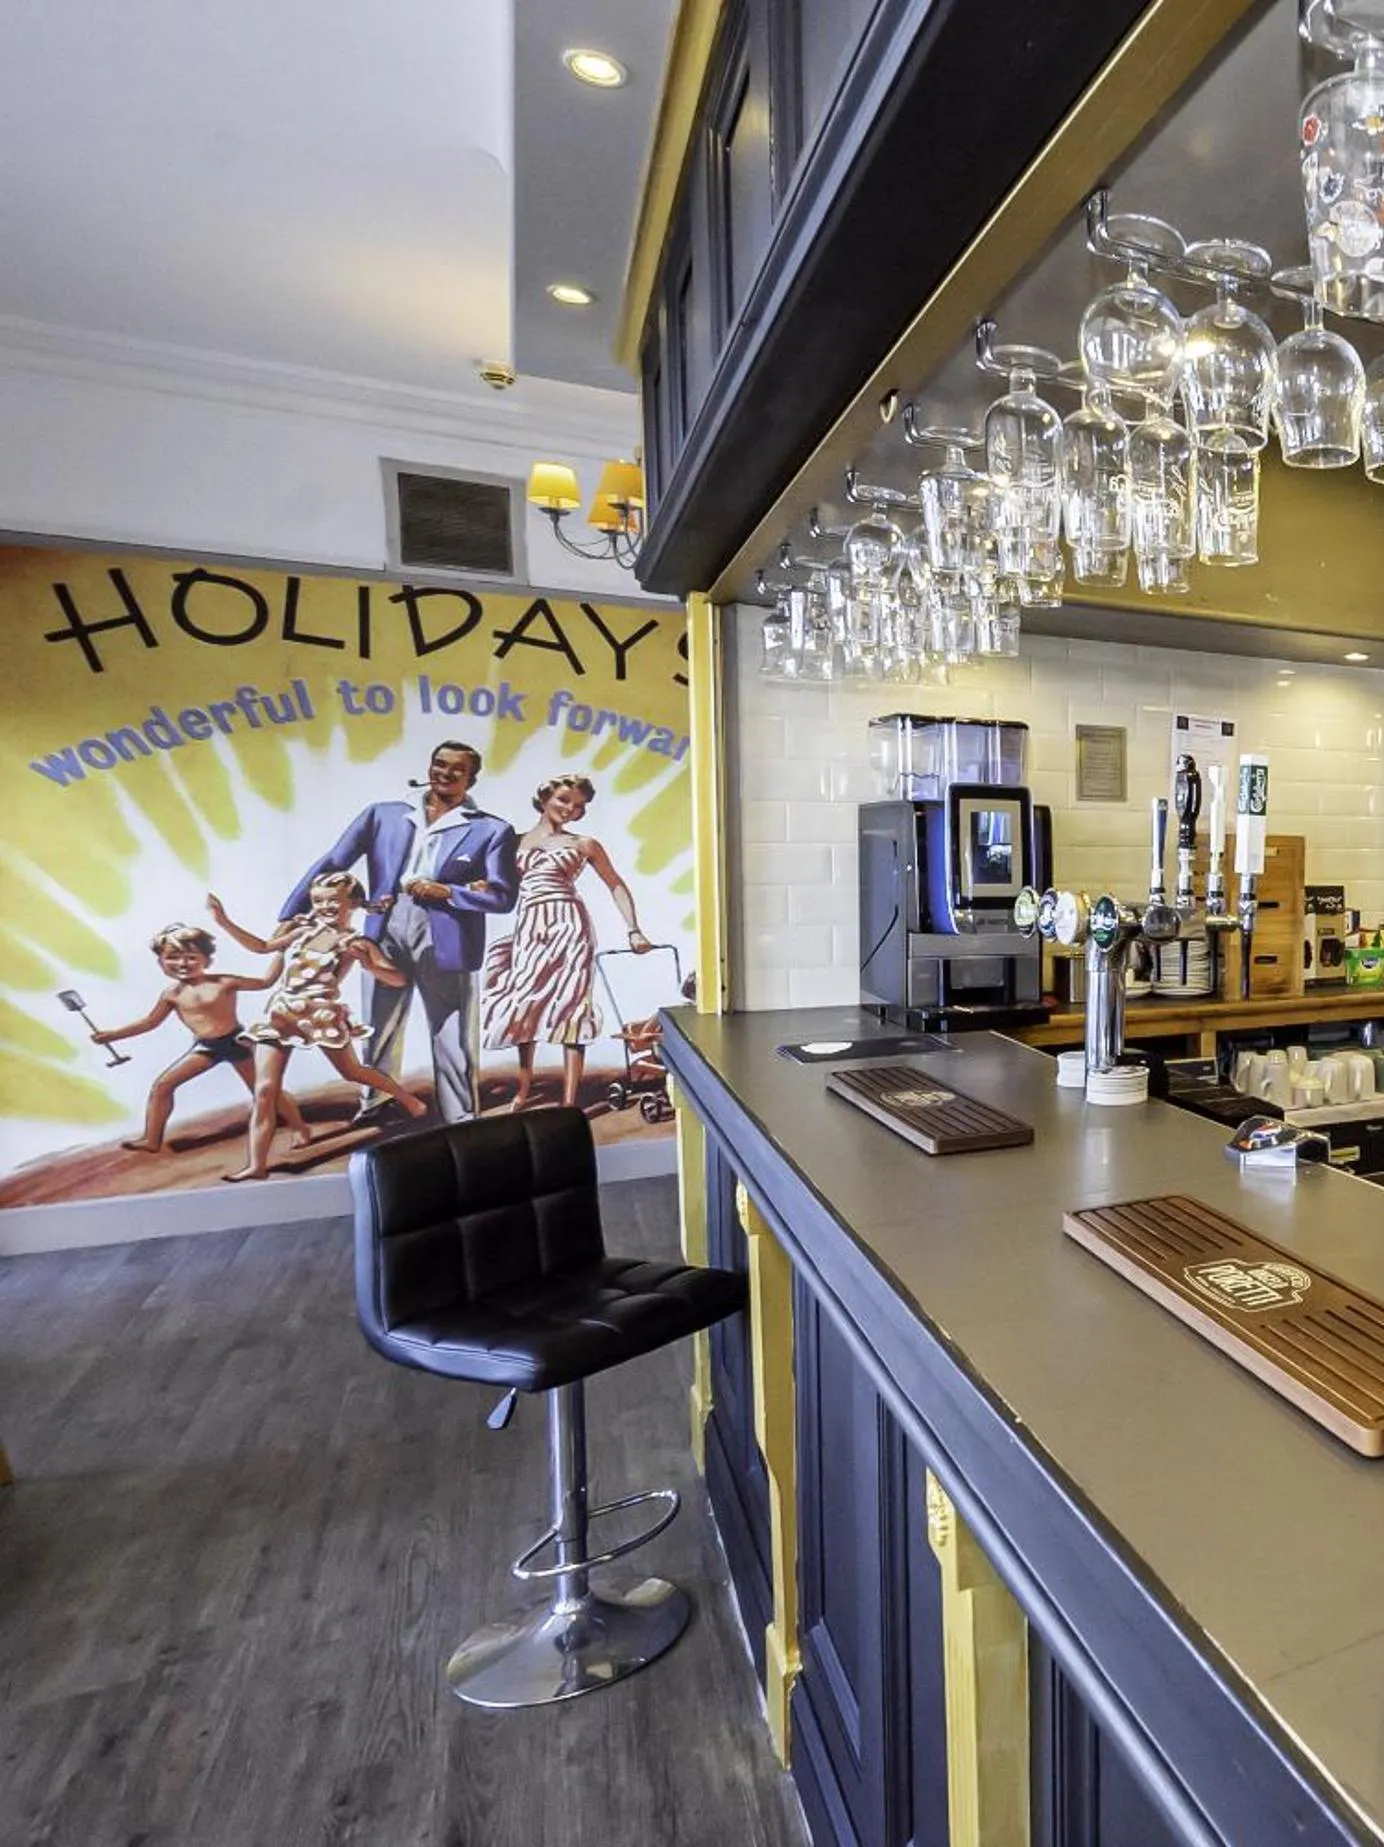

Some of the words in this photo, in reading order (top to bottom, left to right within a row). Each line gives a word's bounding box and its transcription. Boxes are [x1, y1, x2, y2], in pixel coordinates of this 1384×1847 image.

[29, 678, 315, 788] wonderful
[336, 675, 395, 717] to
[419, 674, 529, 721] look
[1198, 1264, 1283, 1306] PORETTI
